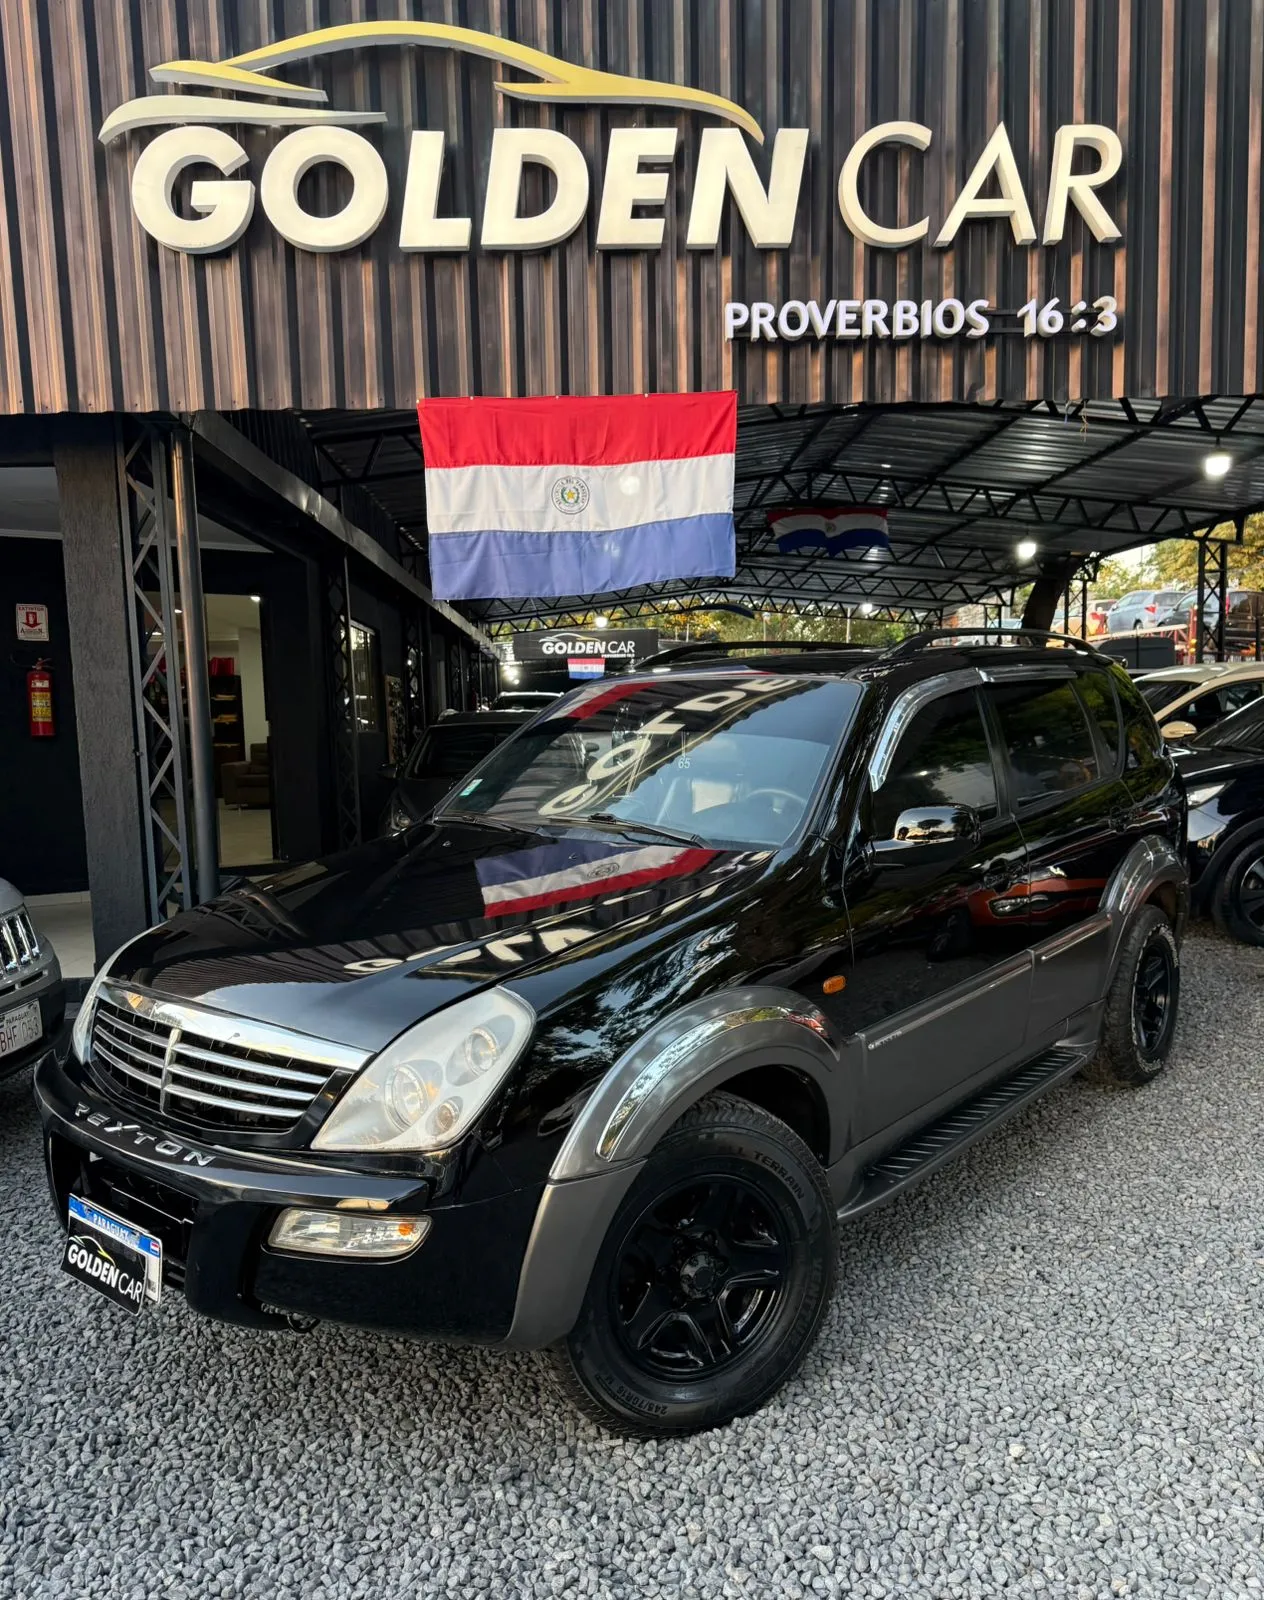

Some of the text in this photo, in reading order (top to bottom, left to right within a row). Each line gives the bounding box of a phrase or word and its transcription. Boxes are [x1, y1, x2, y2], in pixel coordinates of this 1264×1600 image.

[132, 120, 1123, 254] GOLDEN CAR
[725, 297, 990, 341] PROVERBIOS
[542, 640, 636, 655] GOLDEN CAR
[678, 757, 691, 769] 65
[74, 1102, 216, 1166] REXTON
[753, 1150, 805, 1200] TERRAIN
[92, 1213, 130, 1243] PARAGUAY
[68, 1243, 143, 1304] GOLDEN CAR
